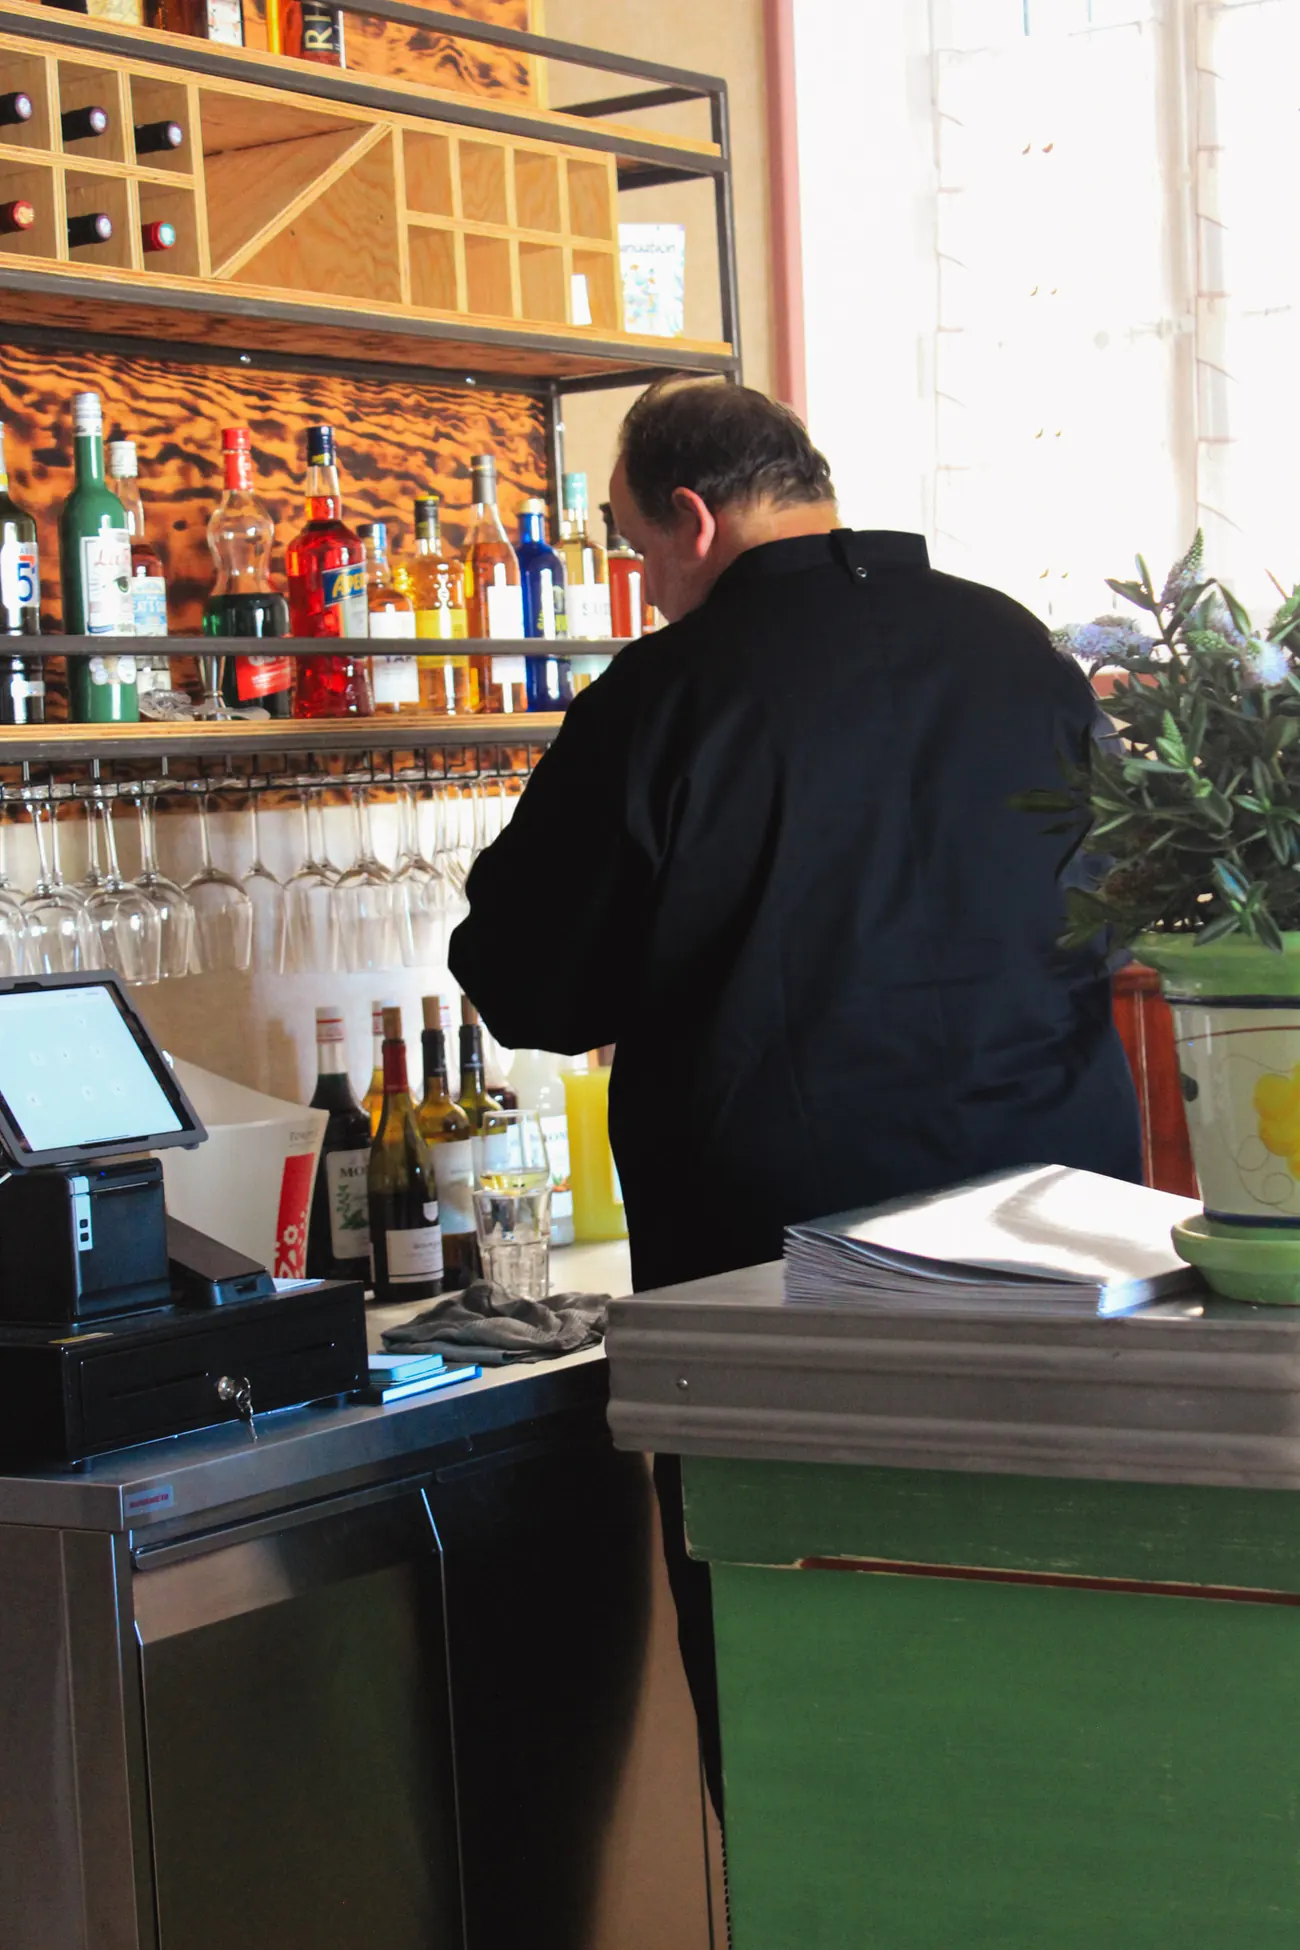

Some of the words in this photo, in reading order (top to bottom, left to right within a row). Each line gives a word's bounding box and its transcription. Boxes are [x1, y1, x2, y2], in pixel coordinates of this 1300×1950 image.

[304, 1, 333, 49] RI
[332, 571, 368, 598] APE
[339, 1166, 366, 1179] MO
